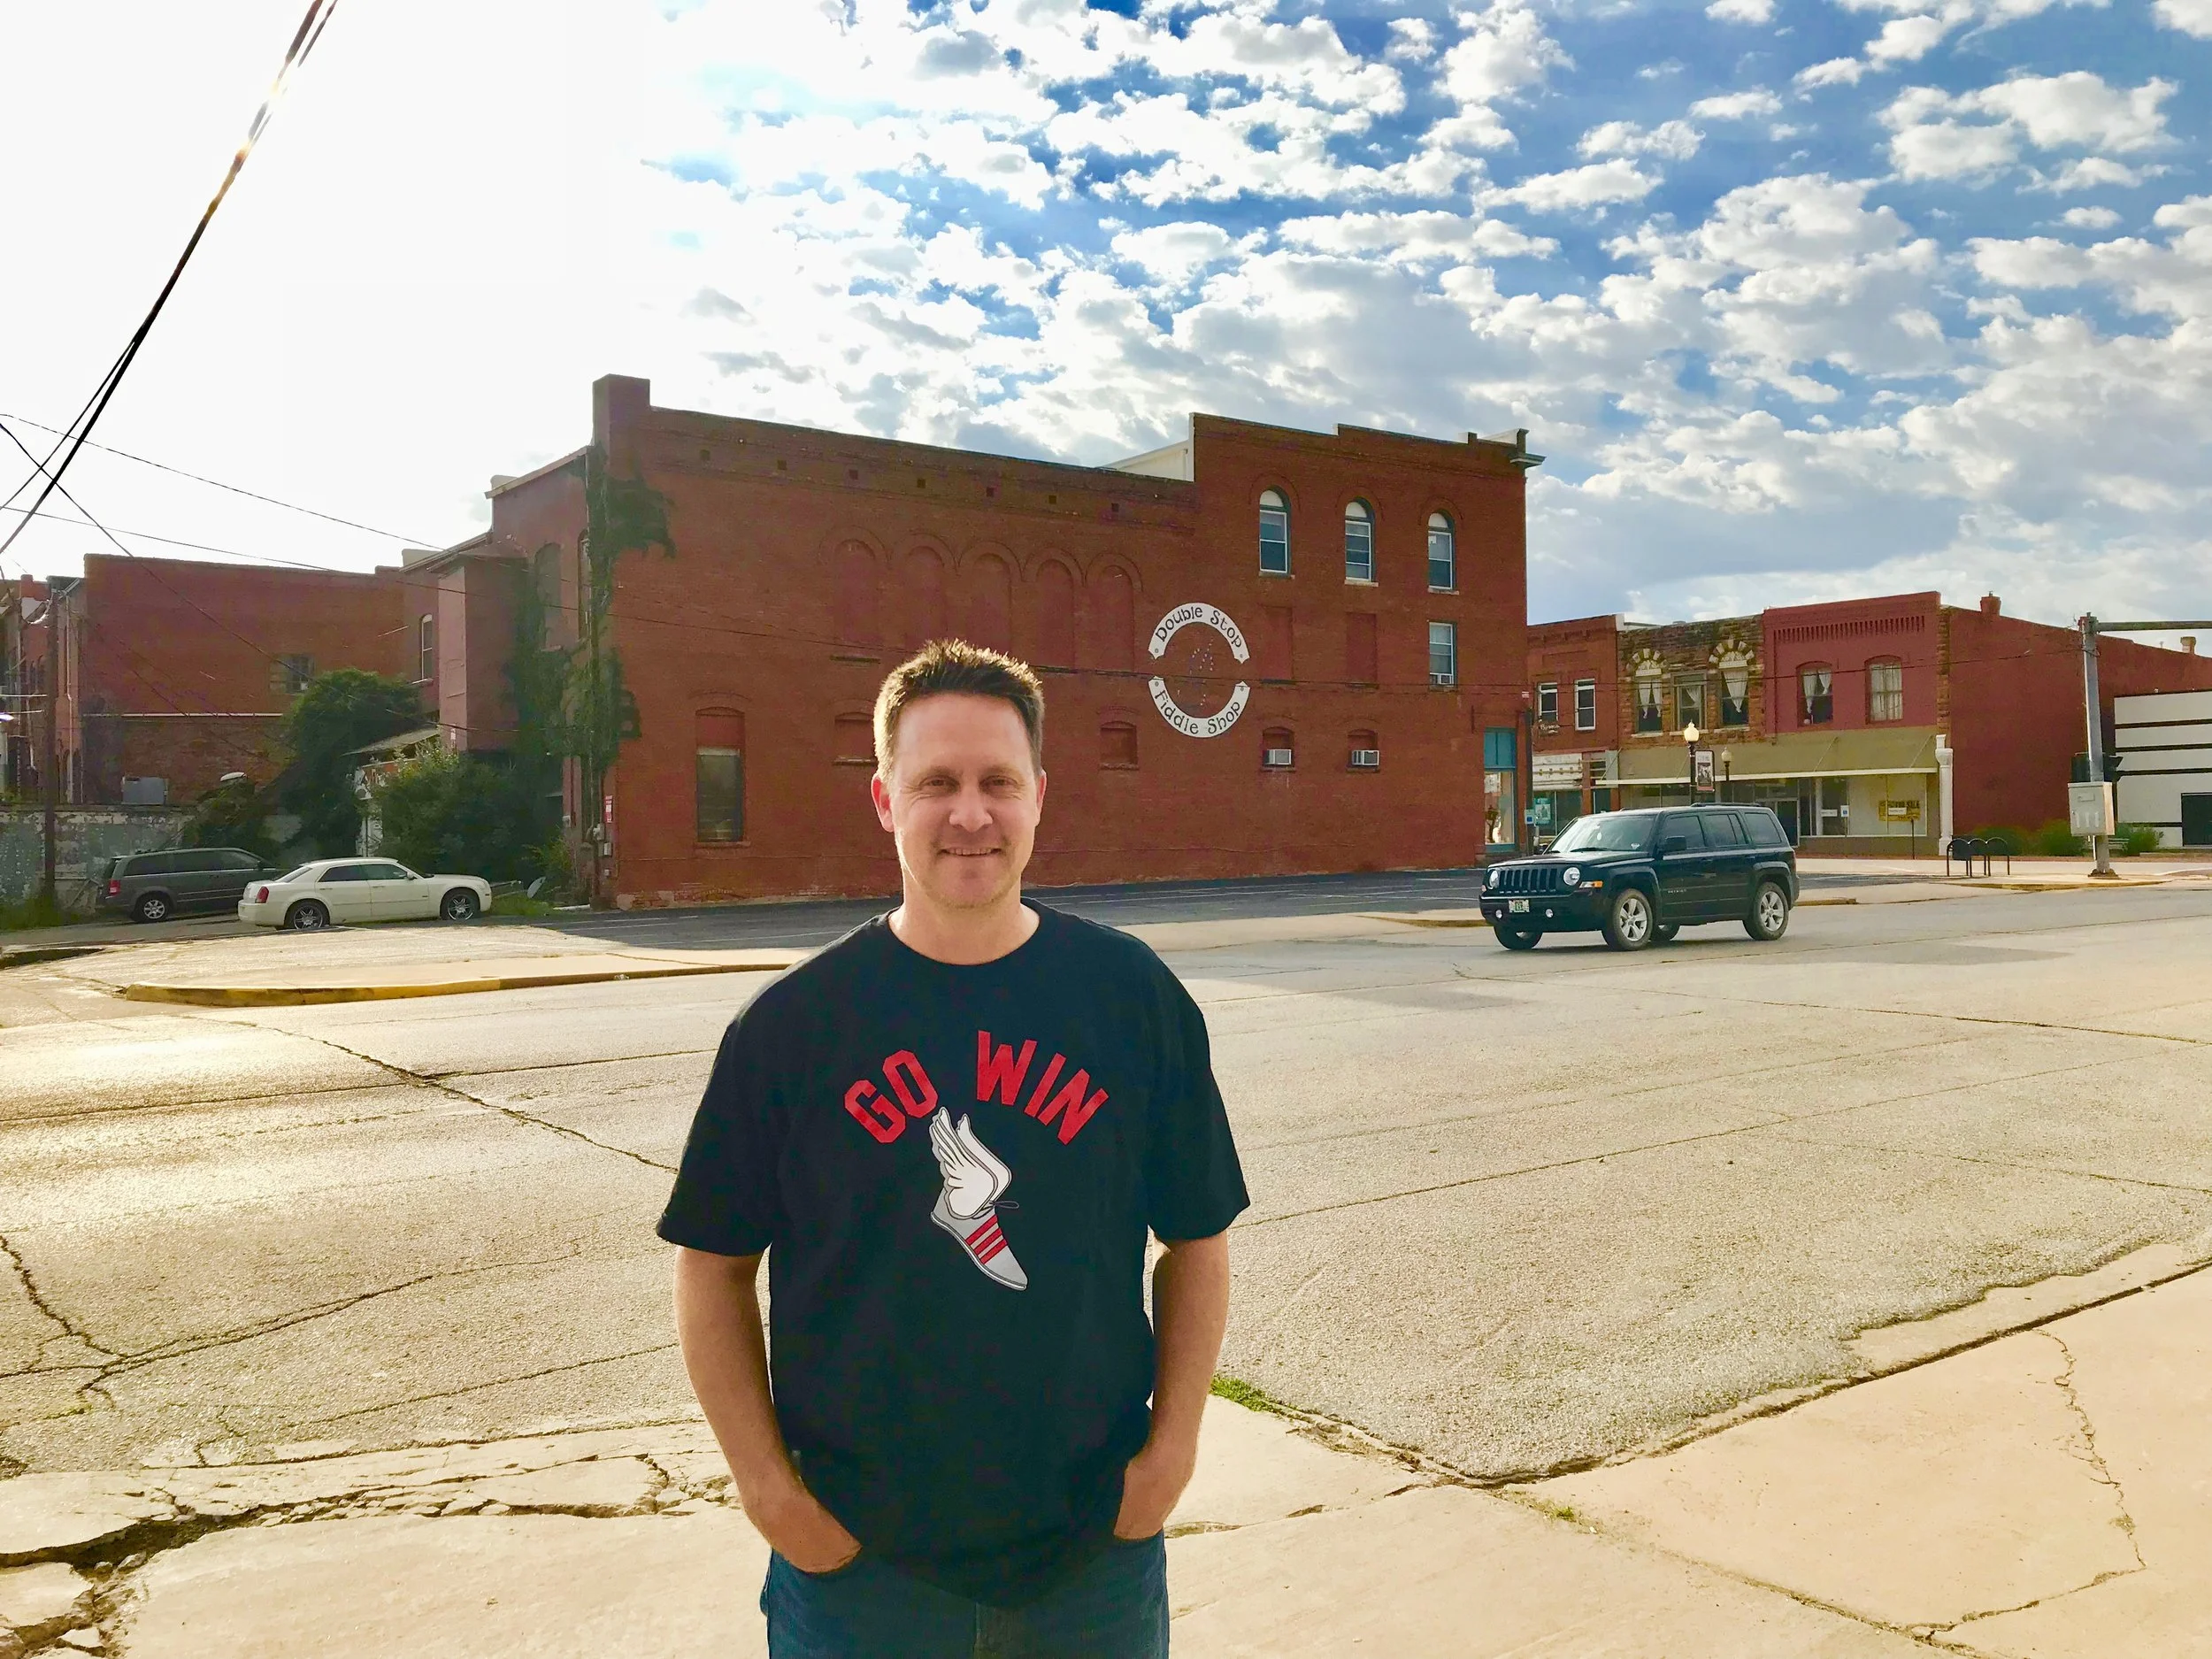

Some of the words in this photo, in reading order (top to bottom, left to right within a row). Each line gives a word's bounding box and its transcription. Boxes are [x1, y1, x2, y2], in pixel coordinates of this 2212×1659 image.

[1155, 606, 1203, 642] Double
[1210, 610, 1242, 648] Stop
[1154, 689, 1199, 734] Fiddle
[1207, 702, 1240, 734] Shop
[844, 1049, 939, 1144] GO
[977, 1030, 1110, 1145] WIN
